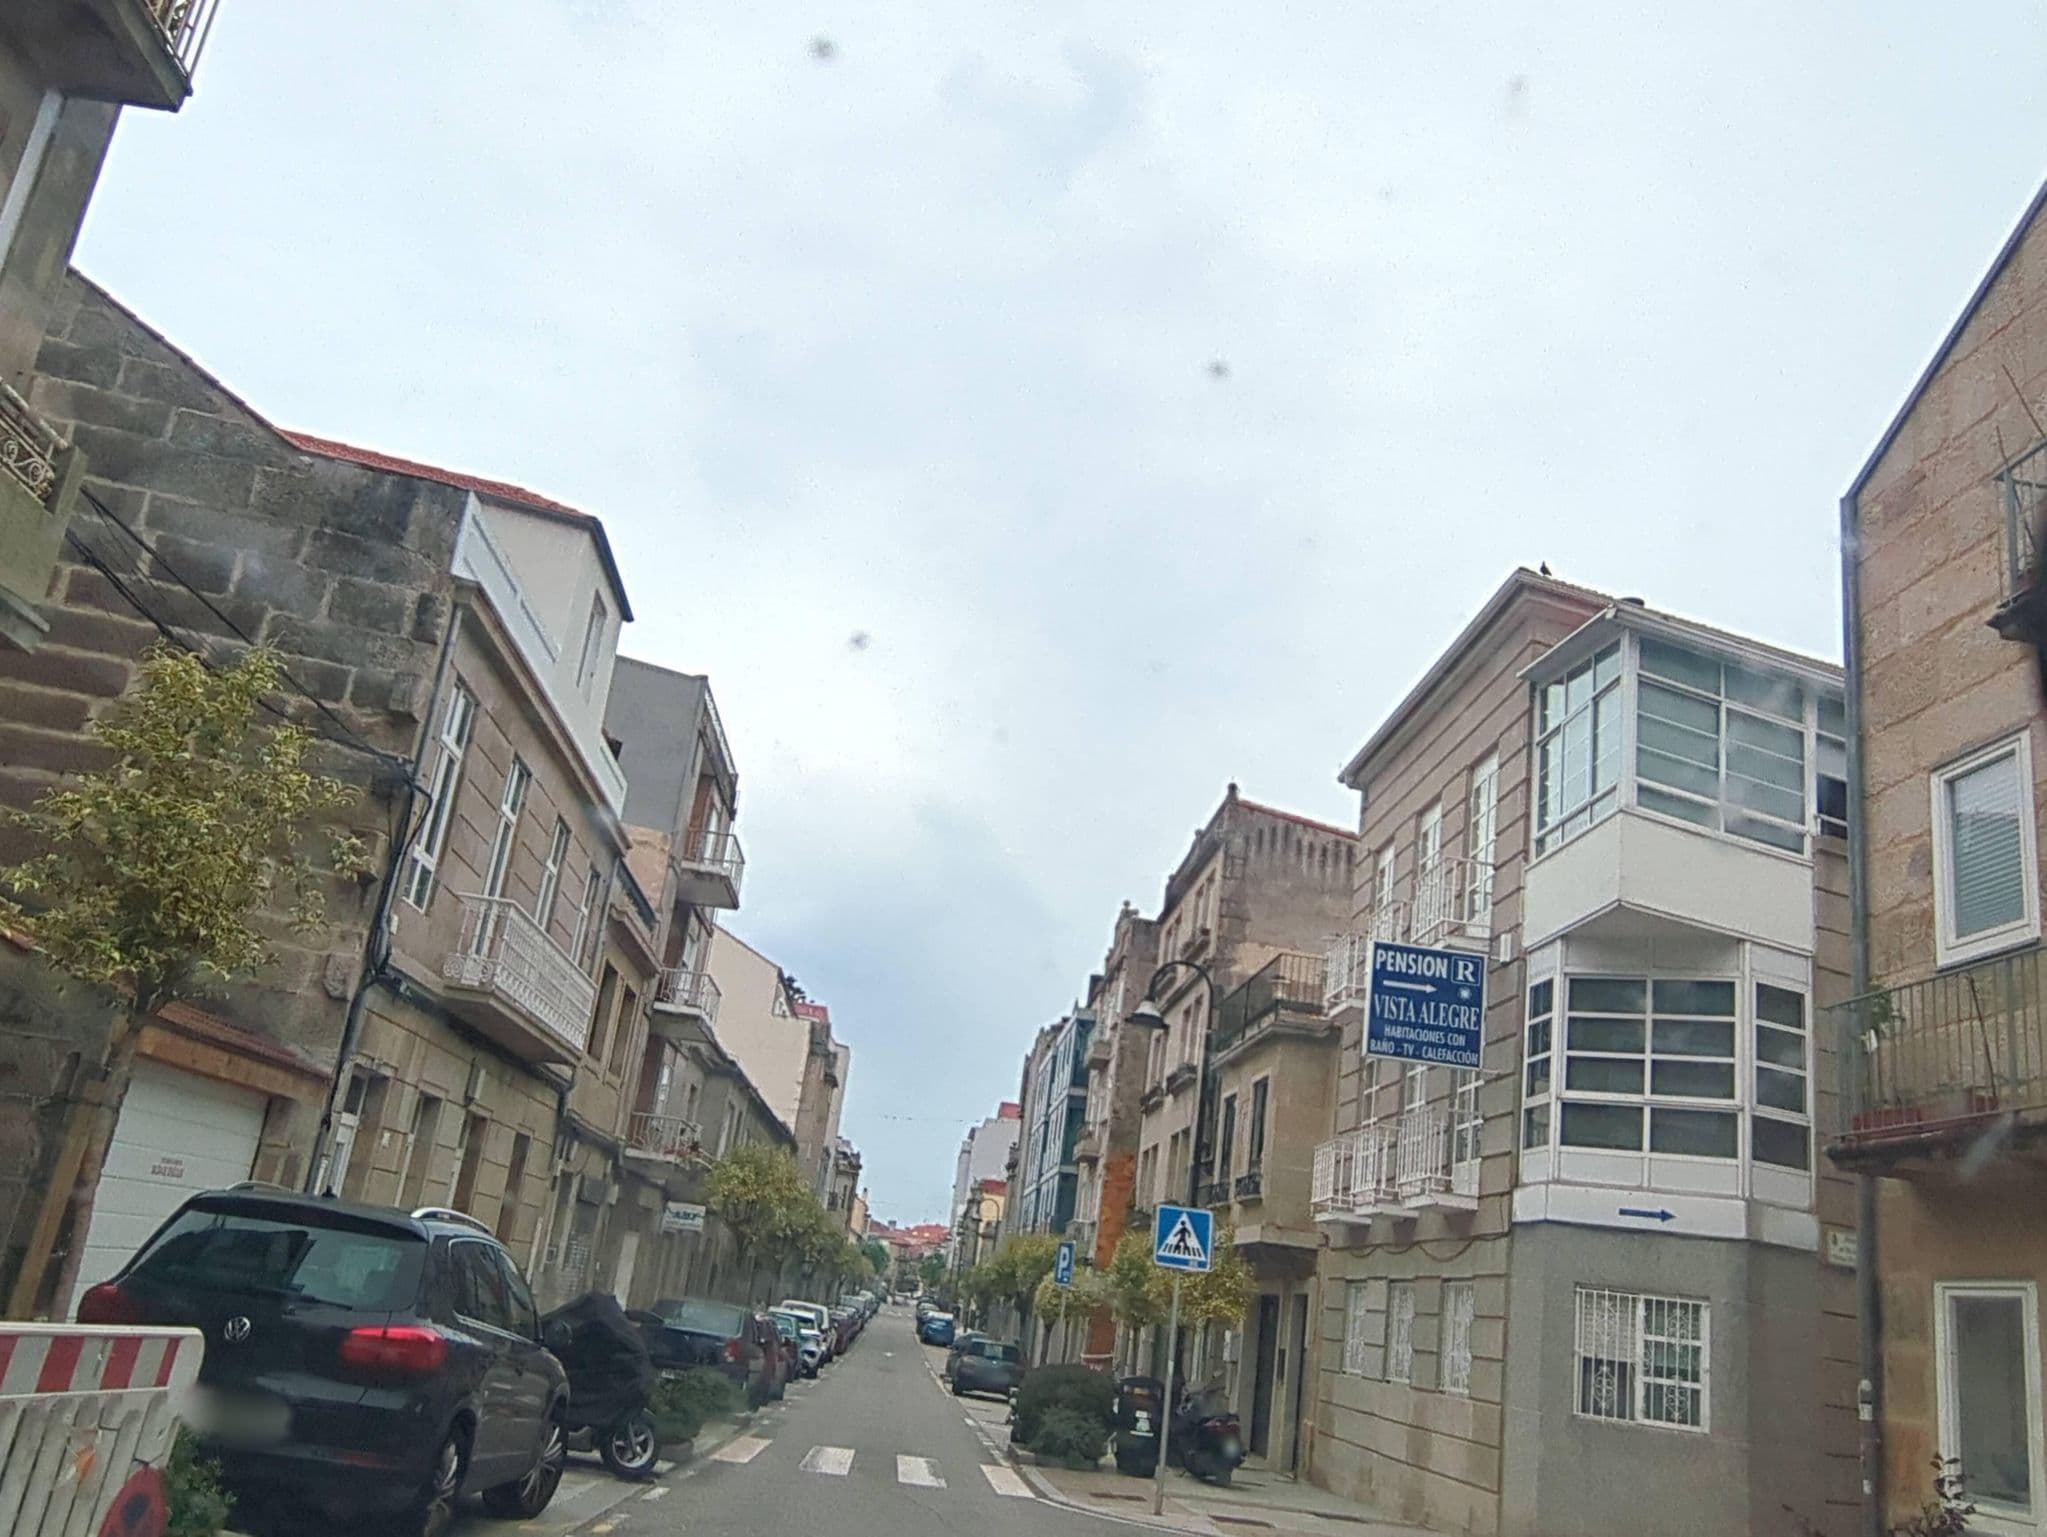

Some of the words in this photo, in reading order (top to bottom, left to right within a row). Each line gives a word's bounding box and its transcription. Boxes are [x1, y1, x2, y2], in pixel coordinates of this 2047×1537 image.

[1375, 949, 1448, 979] PENSION
[1456, 960, 1476, 982] R
[1374, 994, 1416, 1022] VISTA
[1418, 1002, 1479, 1030] ALEGRE
[1384, 1025, 1445, 1043] HABITACIONES
[1447, 1033, 1466, 1047] CON
[1370, 1039, 1395, 1054] BAÑO
[1403, 1044, 1415, 1056] TV
[1422, 1045, 1479, 1065] CALEFACCIÓN
[1058, 1246, 1070, 1279] P
